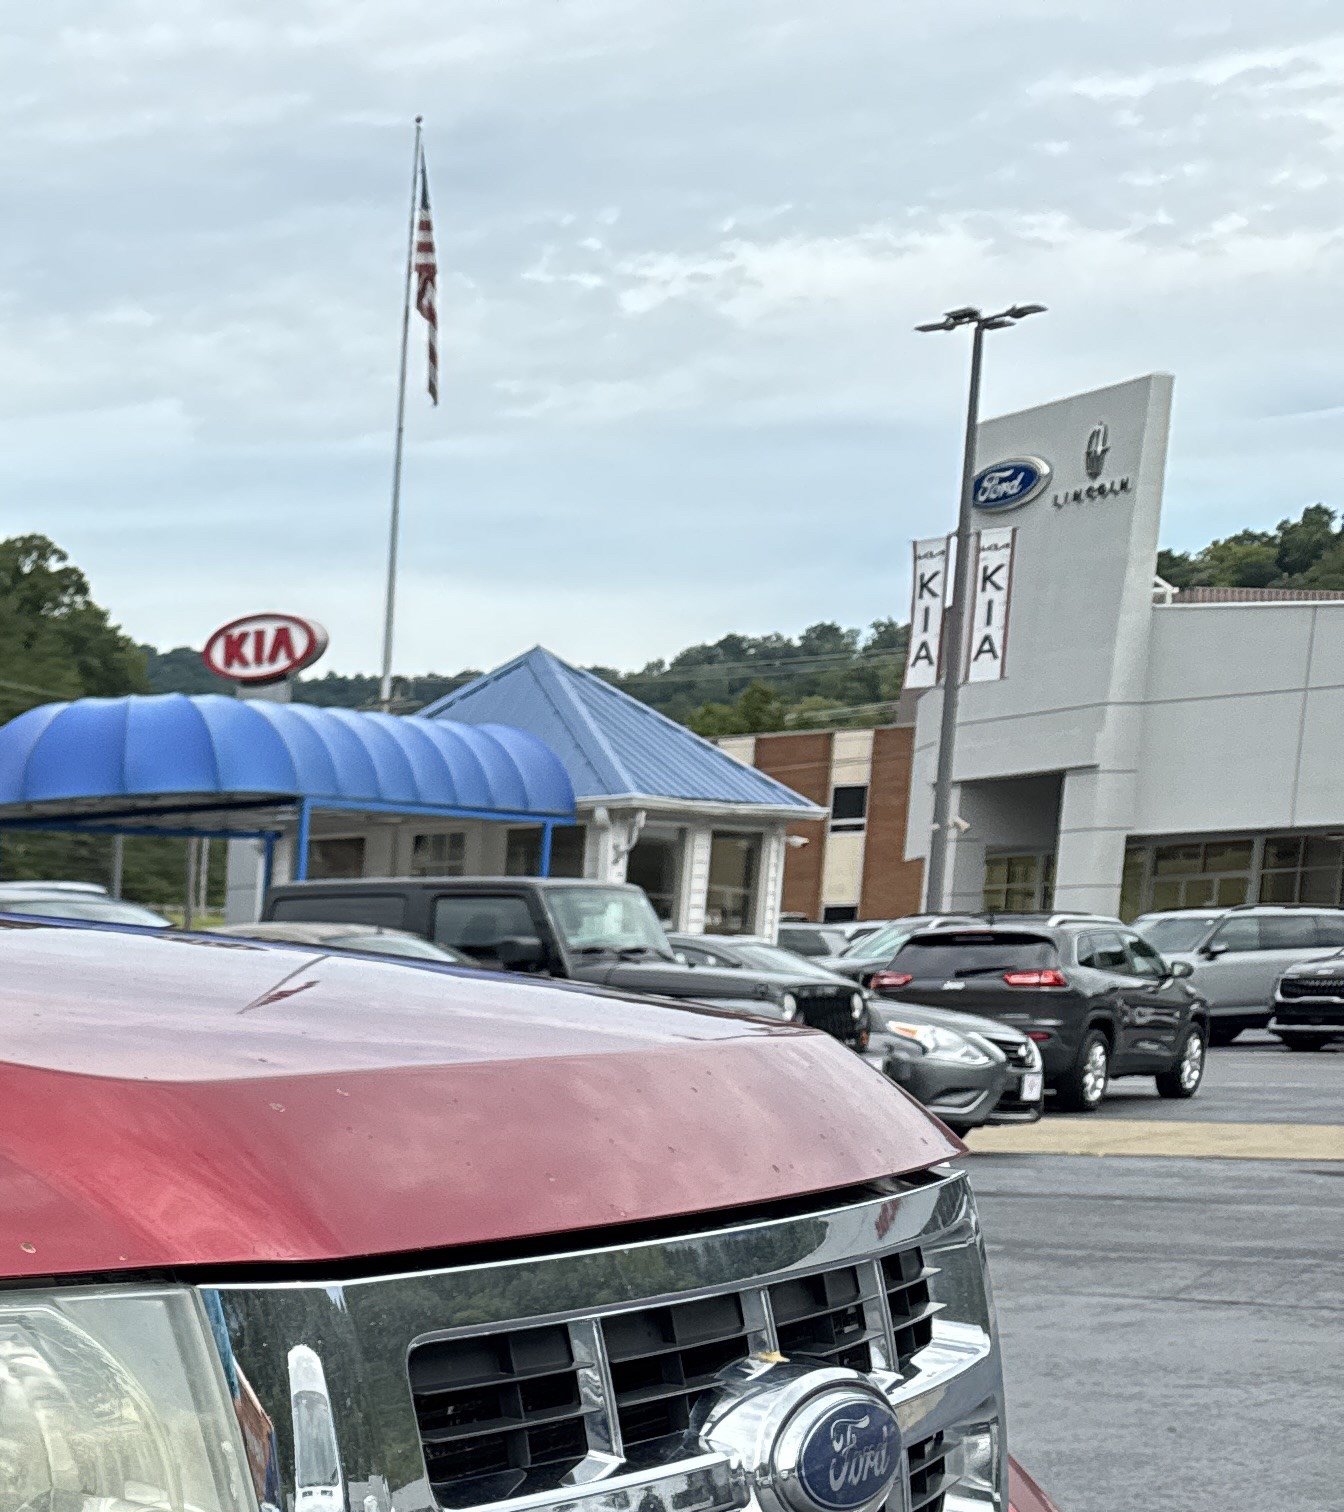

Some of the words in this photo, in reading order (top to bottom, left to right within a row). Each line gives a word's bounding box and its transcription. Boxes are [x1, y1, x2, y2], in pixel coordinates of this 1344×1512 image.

[977, 468, 1025, 501] Ford
[223, 626, 297, 668] KIA
[911, 570, 942, 668] KIA
[973, 562, 1005, 662] KIA
[829, 1414, 890, 1492] Ford
